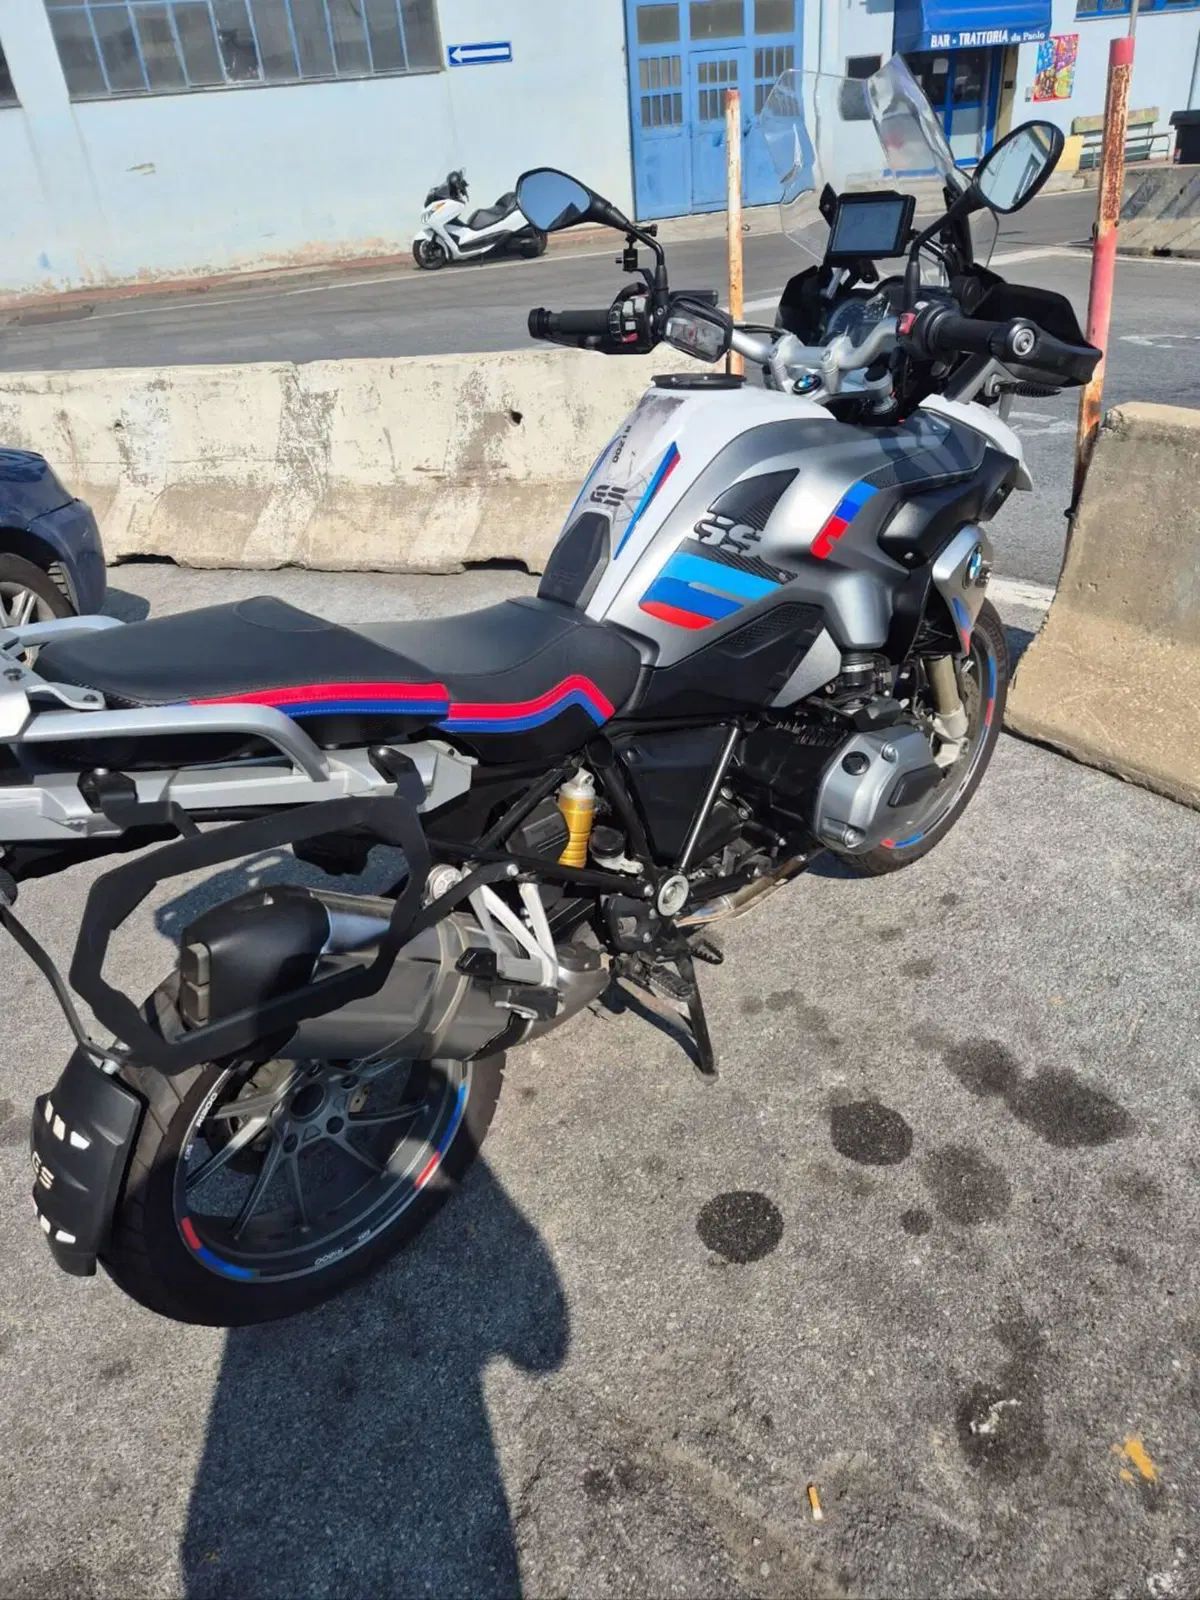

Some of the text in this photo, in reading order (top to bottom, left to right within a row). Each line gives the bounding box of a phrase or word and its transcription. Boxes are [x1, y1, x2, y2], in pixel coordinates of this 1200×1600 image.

[930, 33, 951, 48] BAR
[959, 29, 1009, 46] TRATTORIA
[1023, 30, 1046, 41] Paolo
[695, 512, 768, 559] GS
[31, 1150, 55, 1190] GS
